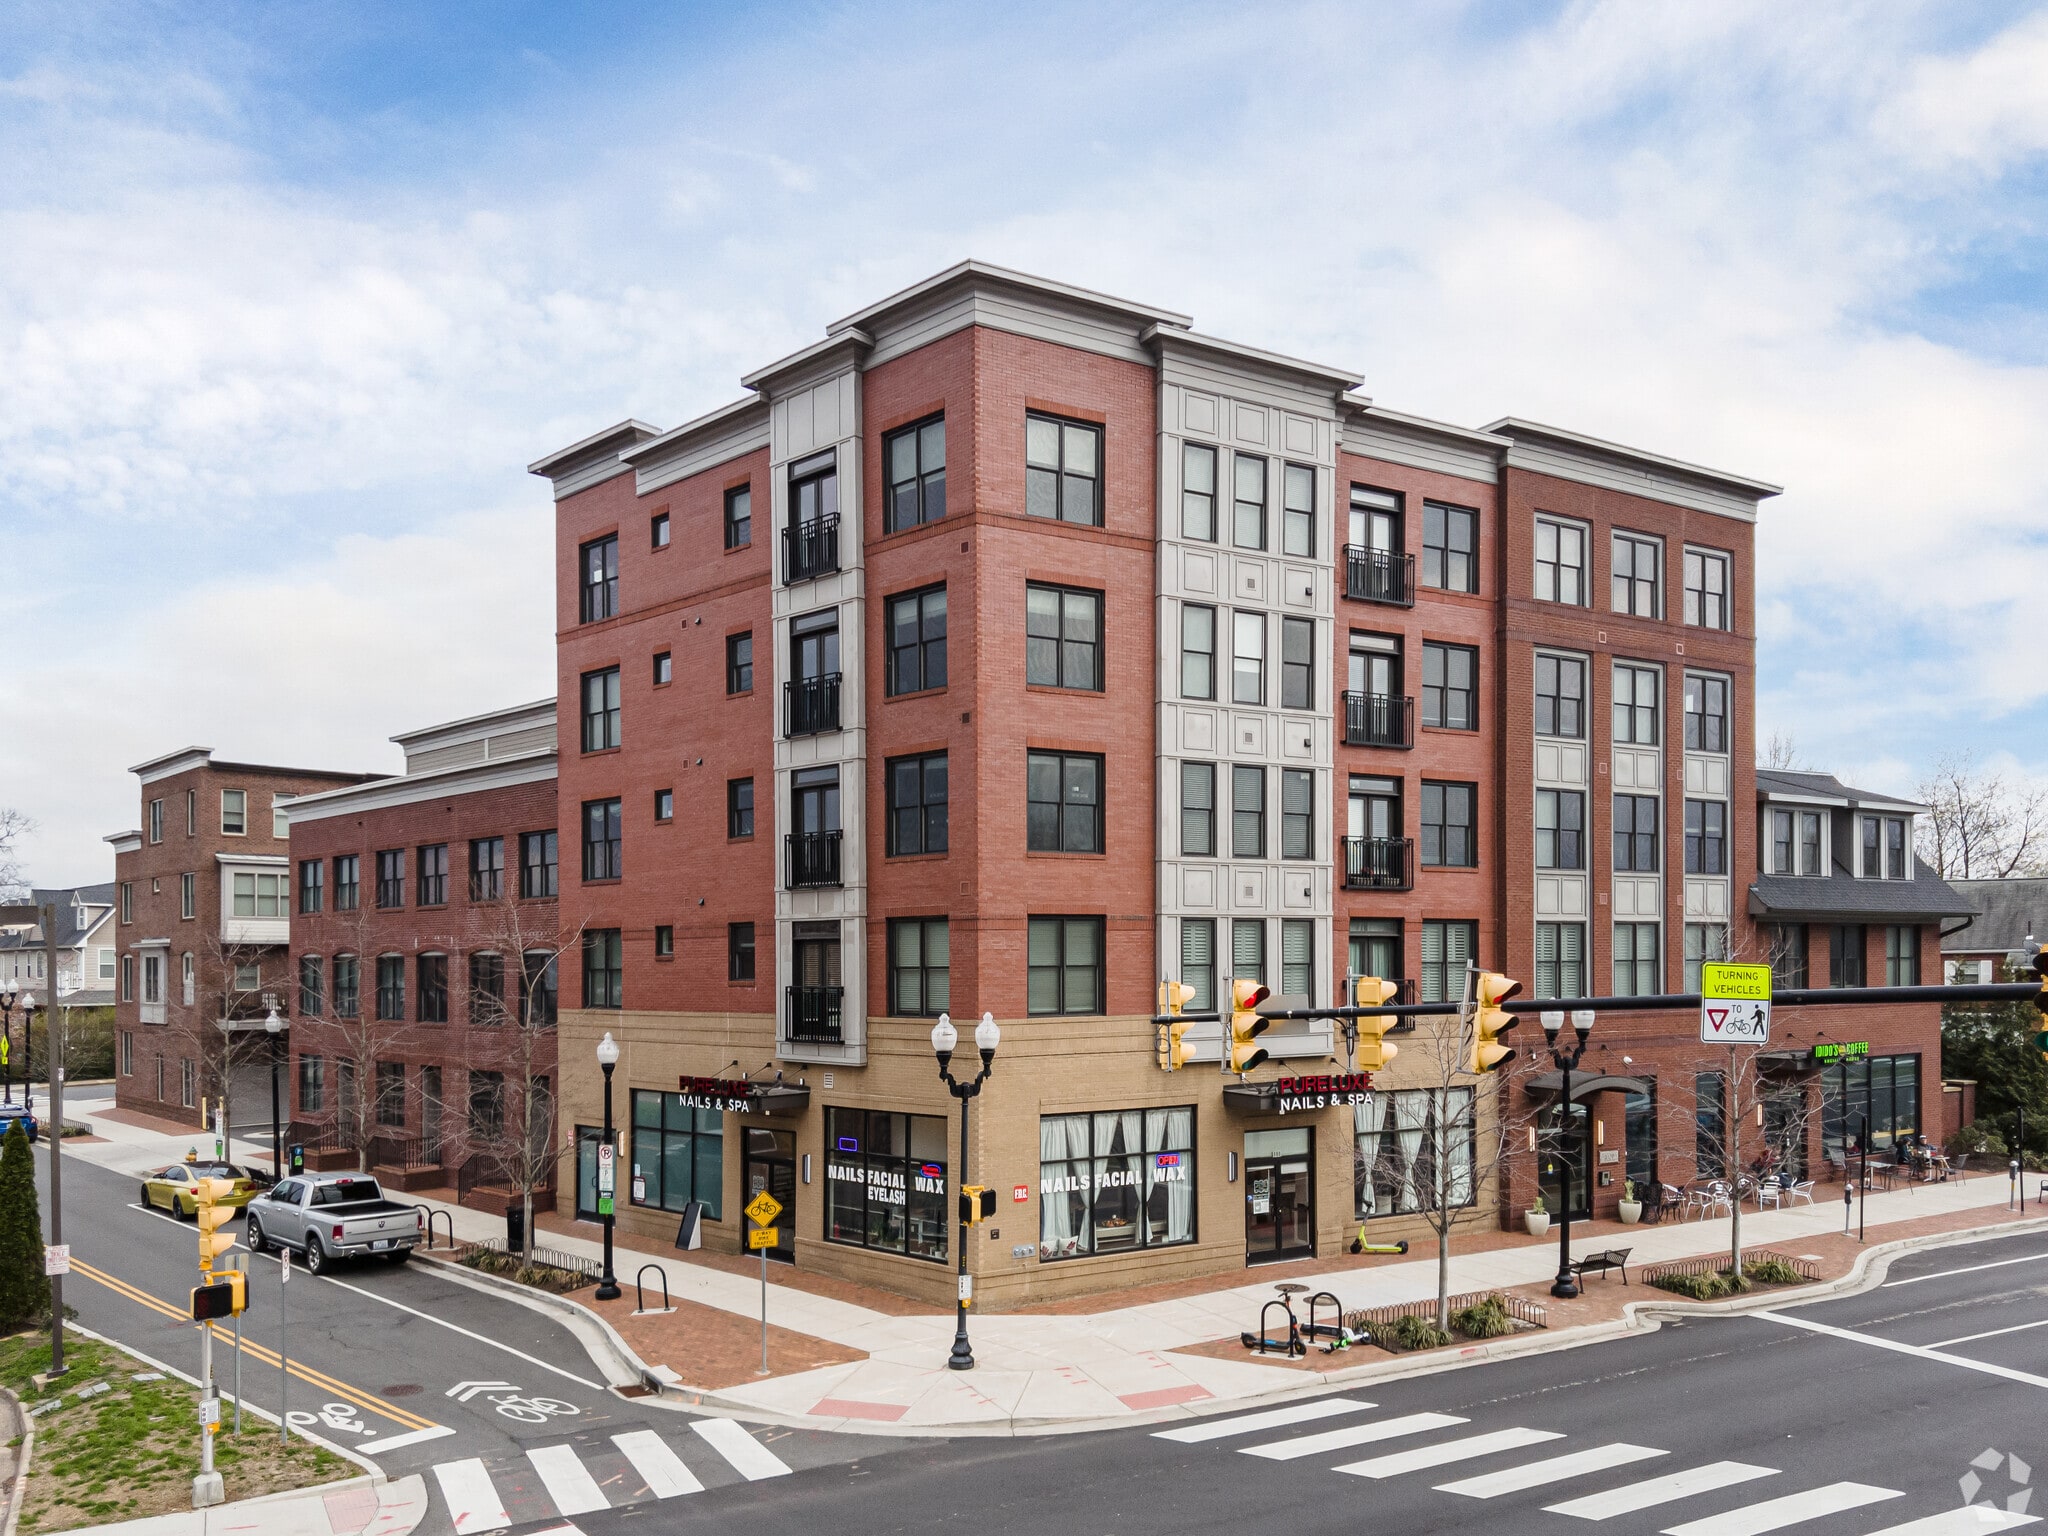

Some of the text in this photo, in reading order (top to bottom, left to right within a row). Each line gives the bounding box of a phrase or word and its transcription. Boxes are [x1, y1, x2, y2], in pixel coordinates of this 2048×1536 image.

[1717, 971, 1758, 981] TURNING
[1714, 985, 1761, 995] VEHICLES
[1732, 1005, 1742, 1014] TO
[1846, 1041, 1869, 1055] COFFEE
[679, 1076, 749, 1098] PURELUXE
[1281, 1072, 1374, 1095] PURELUXE
[679, 1094, 750, 1113] NAILS & SPA
[1280, 1092, 1374, 1112] NAILS & SPA
[1157, 1155, 1179, 1166] OPEN
[828, 1165, 864, 1184] NAILS
[867, 1169, 906, 1190] FACIAL
[915, 1176, 944, 1195] WAX
[1040, 1166, 1186, 1195] NAILS FACIAL WAX
[867, 1186, 906, 1206] EYELASH
